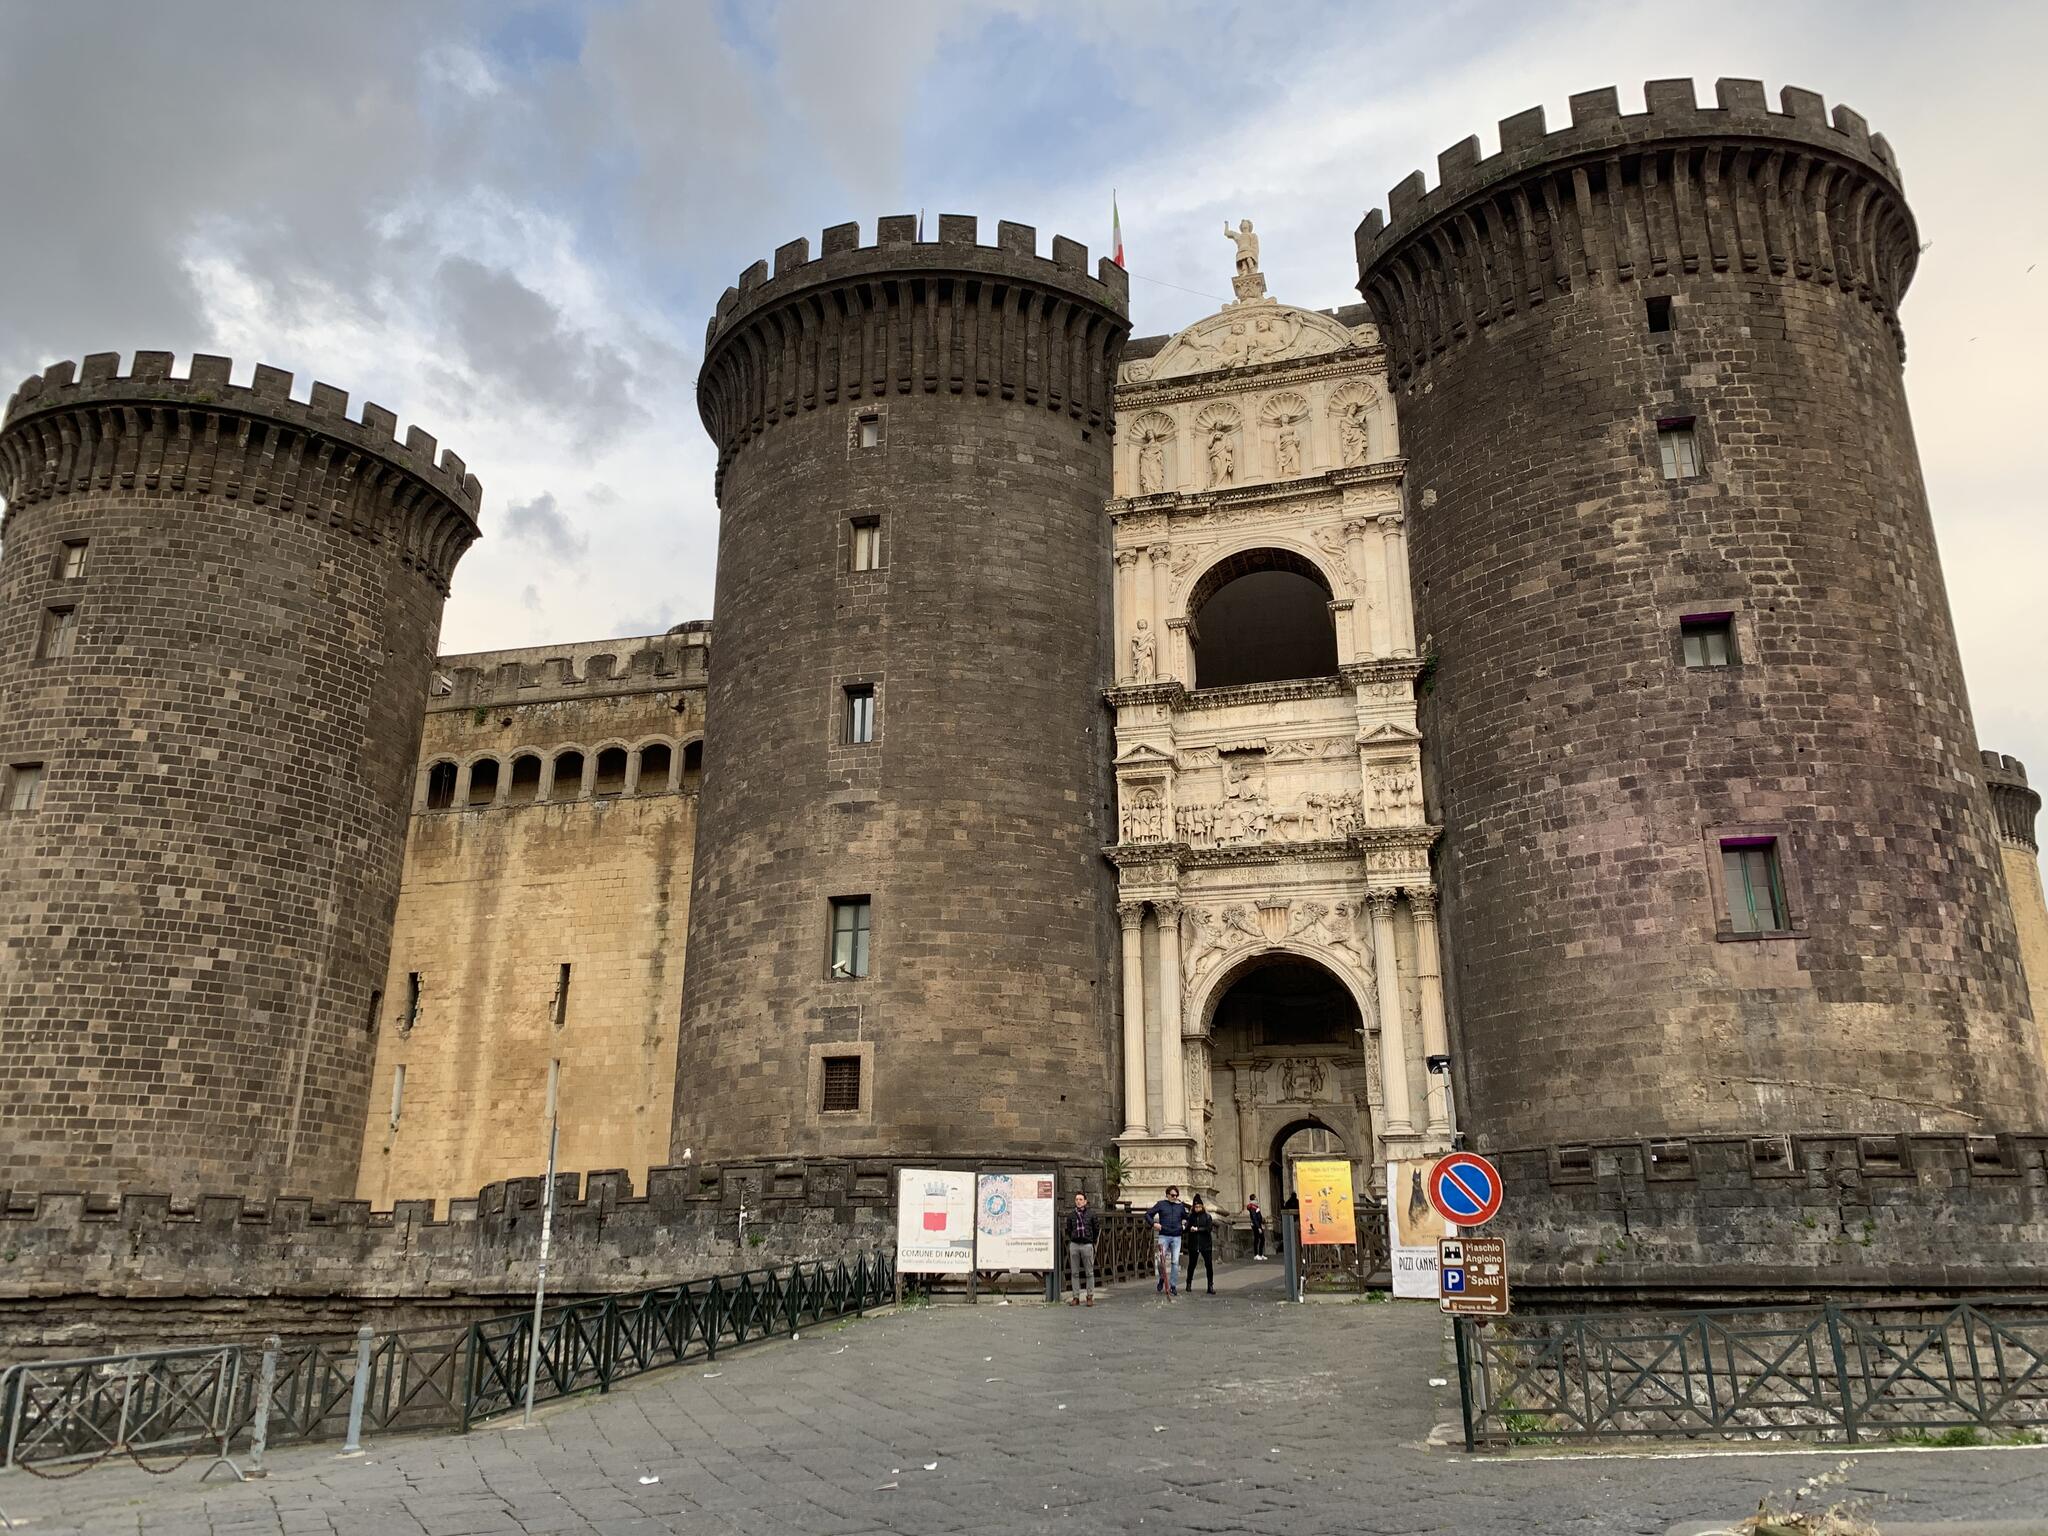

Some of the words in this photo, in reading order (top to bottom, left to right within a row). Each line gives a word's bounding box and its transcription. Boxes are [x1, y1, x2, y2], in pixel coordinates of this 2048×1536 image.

[1465, 1243, 1501, 1252] Maschio
[901, 1249, 934, 1258] COMUNE
[935, 1250, 943, 1258] DI
[944, 1249, 970, 1258] NAPOLI
[1399, 1257, 1414, 1271] PIZZI
[1465, 1254, 1503, 1264] Angioino
[1447, 1271, 1460, 1289] P
